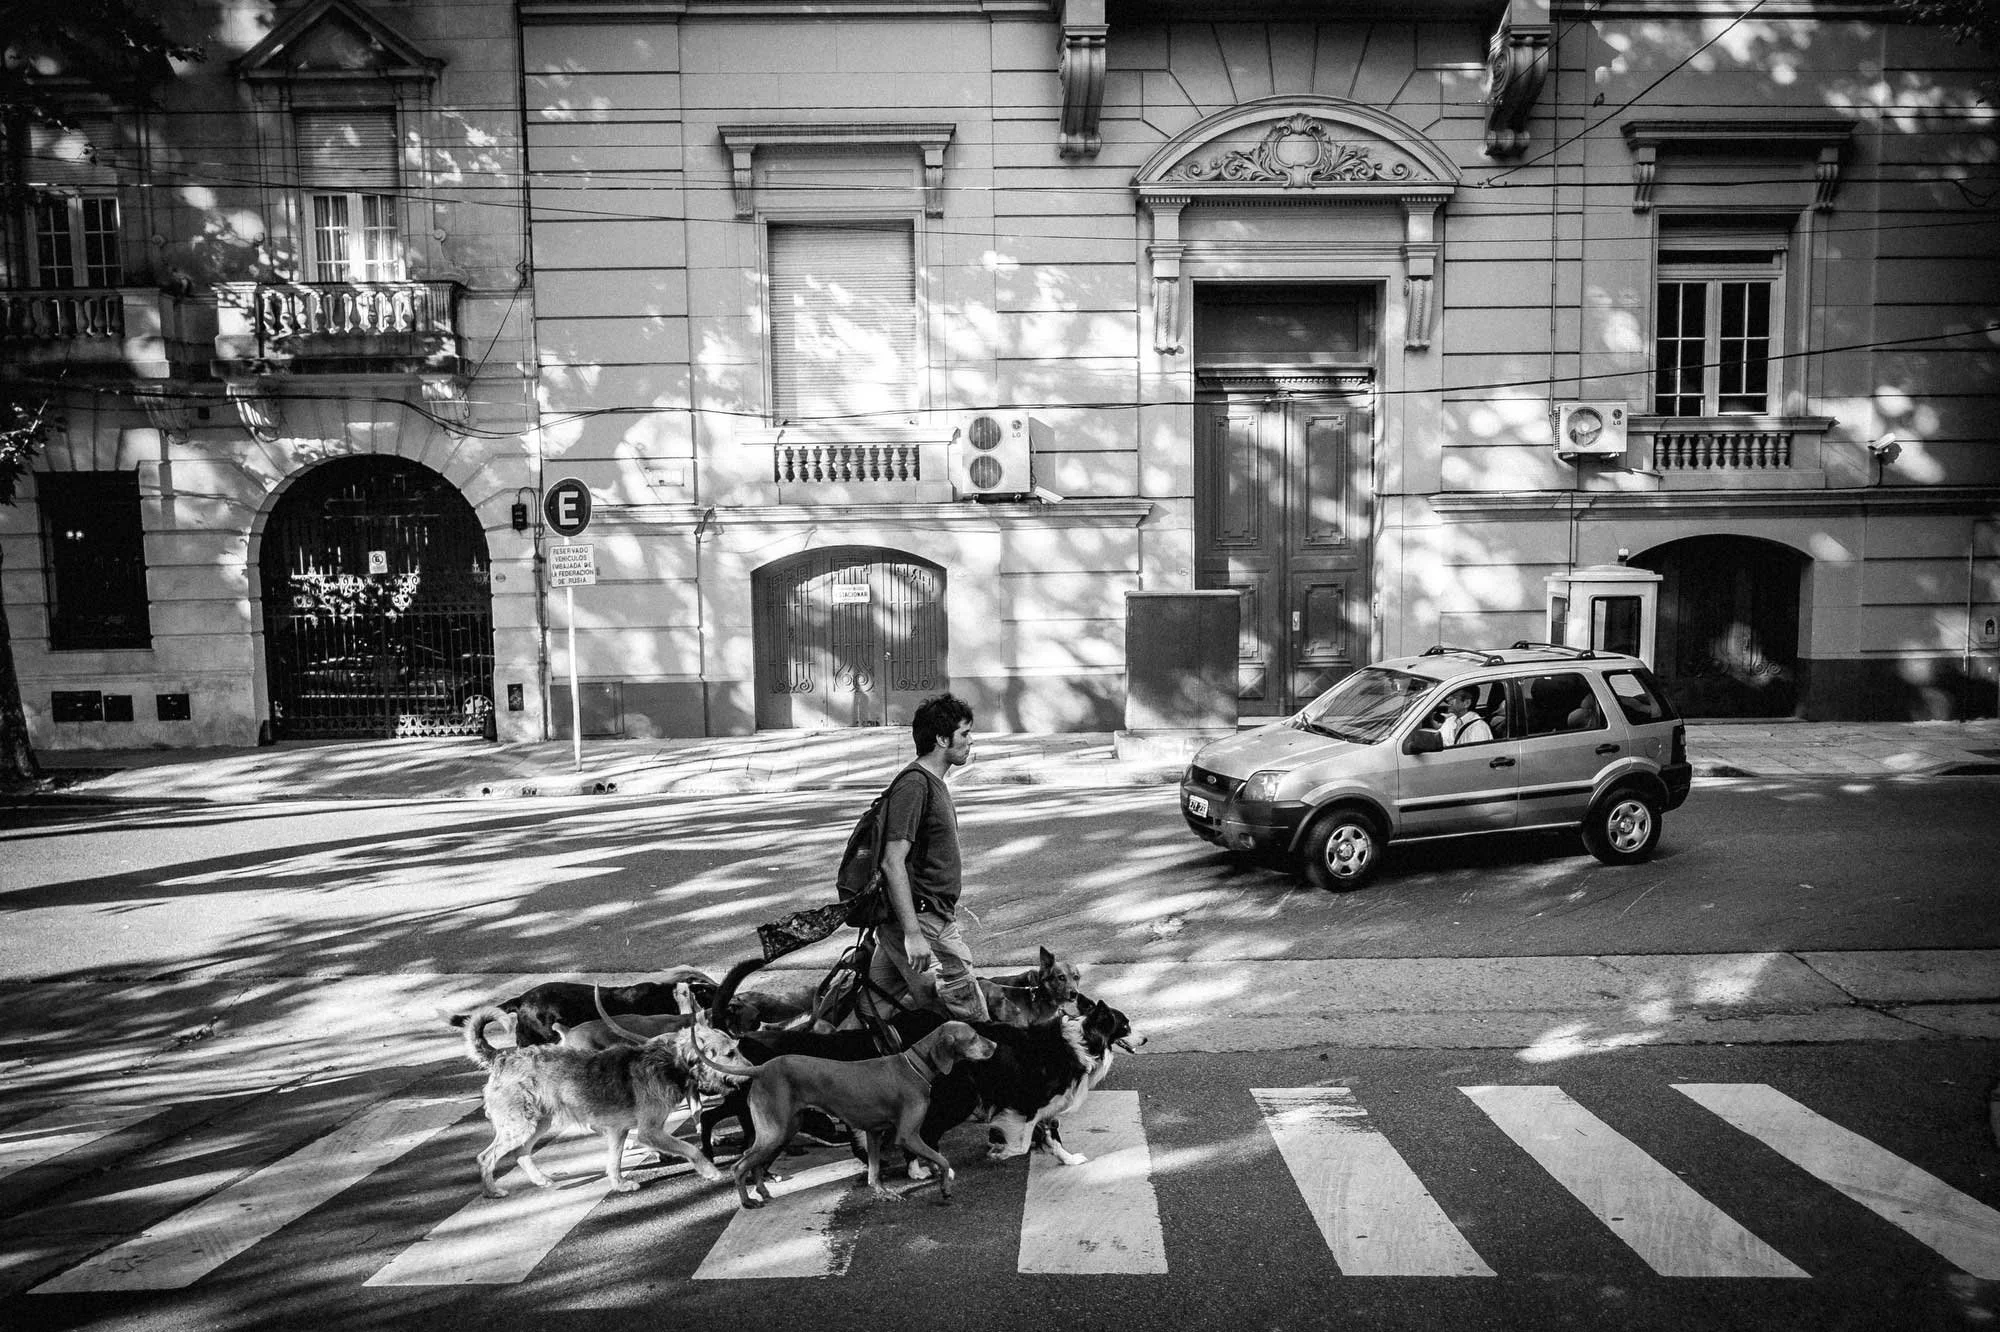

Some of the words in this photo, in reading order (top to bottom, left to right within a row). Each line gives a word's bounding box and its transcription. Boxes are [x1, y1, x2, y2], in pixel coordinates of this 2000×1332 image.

[559, 491, 579, 525] E
[552, 547, 589, 555] RESERVADO
[555, 554, 588, 562] VEHICULOS
